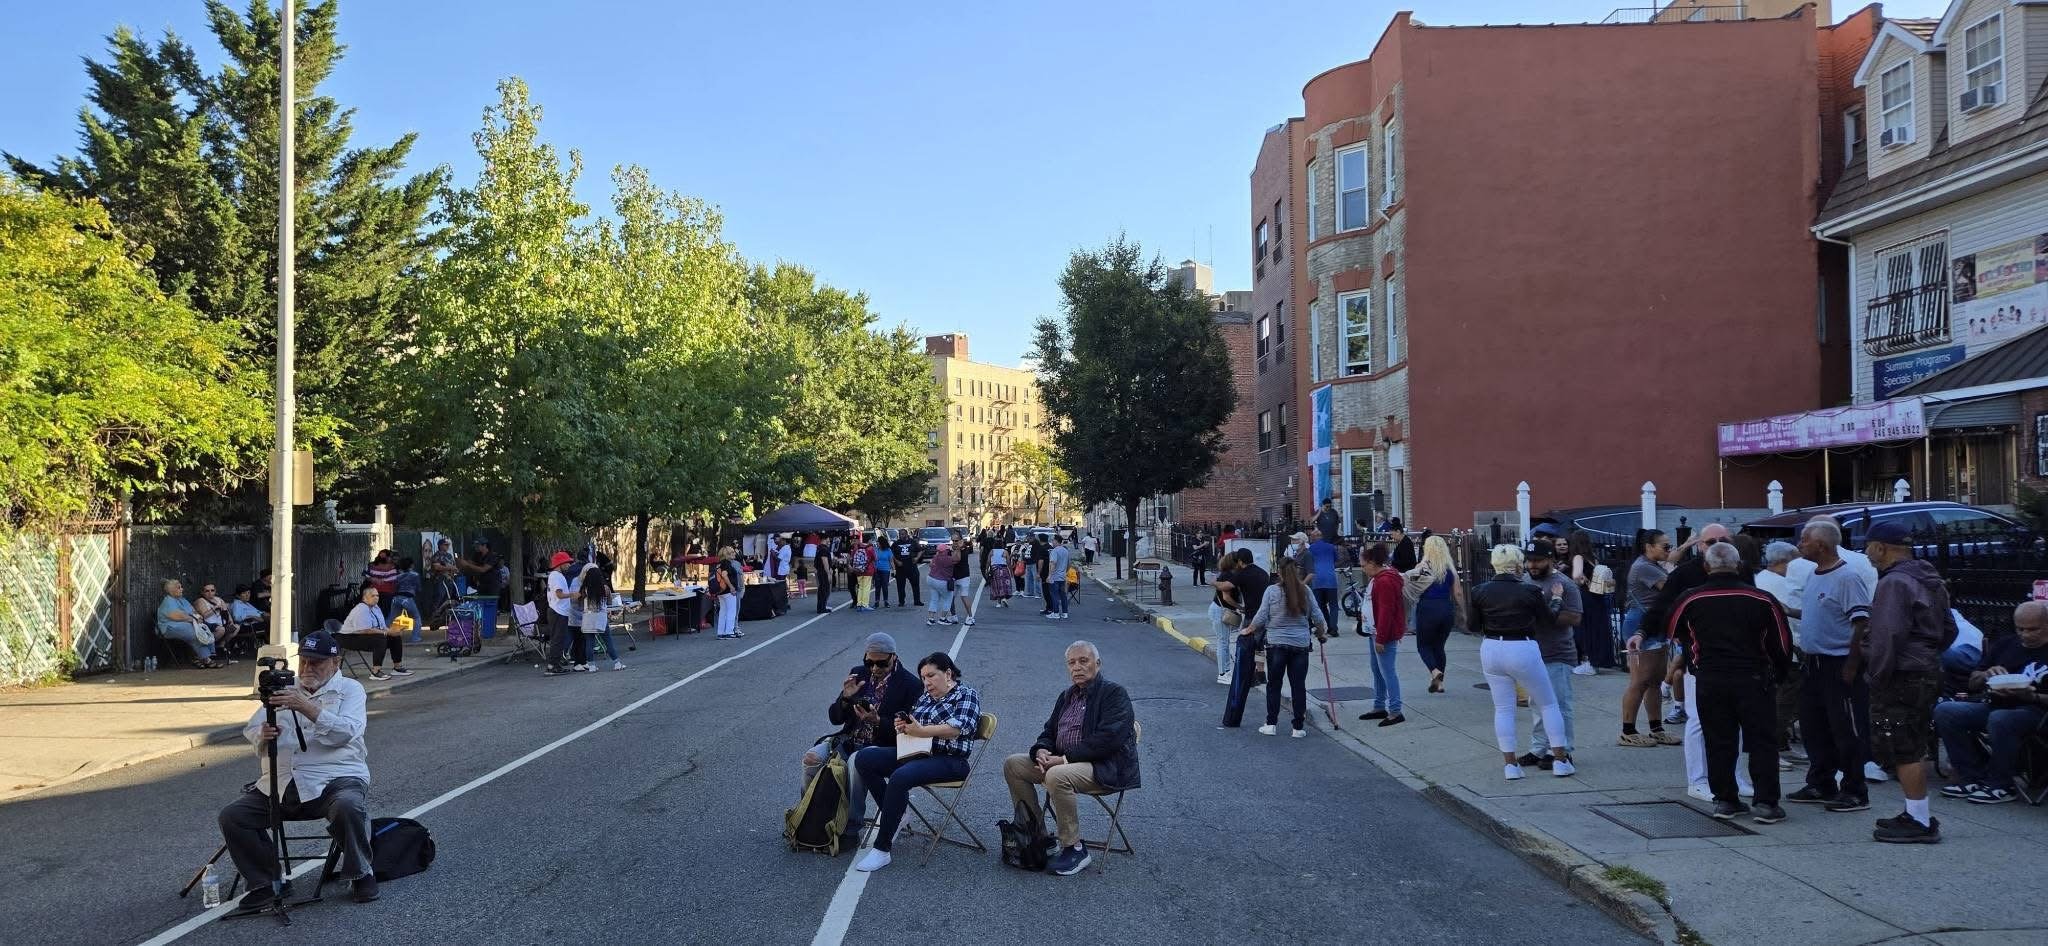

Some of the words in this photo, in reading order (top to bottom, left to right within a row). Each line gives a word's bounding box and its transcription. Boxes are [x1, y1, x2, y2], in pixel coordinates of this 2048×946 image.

[1884, 361, 1915, 372] Summer
[1916, 353, 1951, 367] Programs
[1883, 374, 1911, 387] Specials
[1743, 422, 1769, 435] Little
